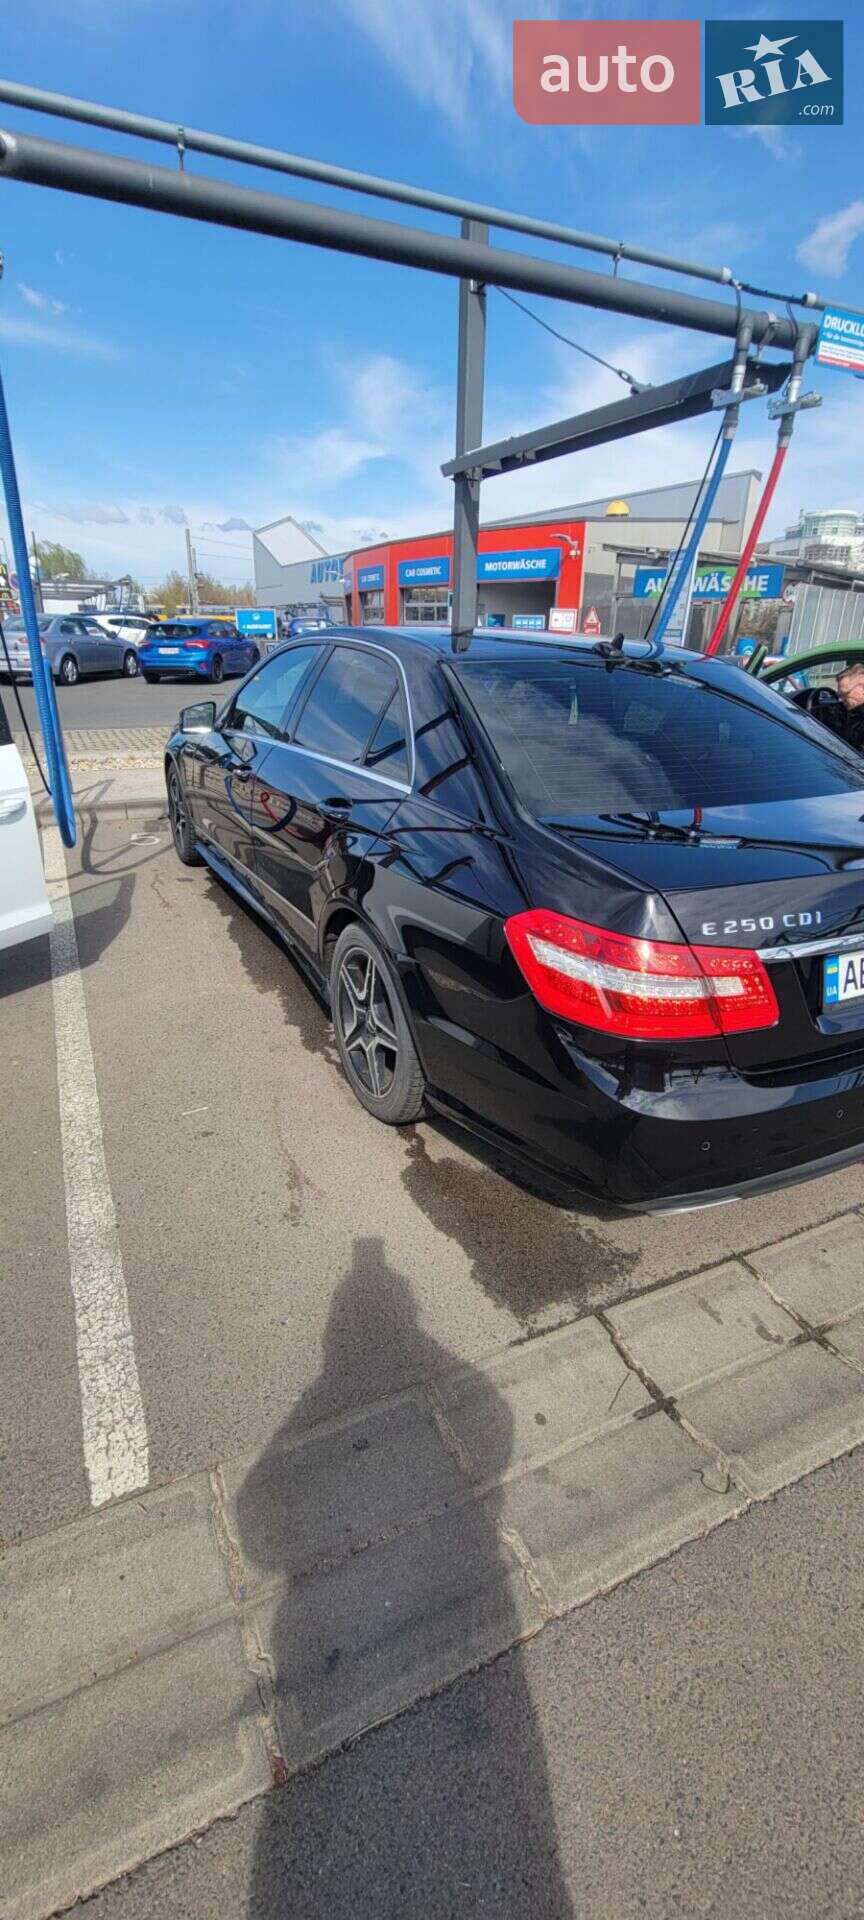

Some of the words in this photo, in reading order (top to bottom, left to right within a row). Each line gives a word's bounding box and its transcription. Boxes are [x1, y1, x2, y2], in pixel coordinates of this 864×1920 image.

[484, 558, 547, 571] MOTORWÄSCHE
[405, 568, 415, 577] CAR
[416, 566, 442, 576] COSMETIC
[702, 922, 718, 936] E
[723, 916, 775, 934] 250
[782, 911, 823, 927] CDI
[826, 985, 838, 996] UA
